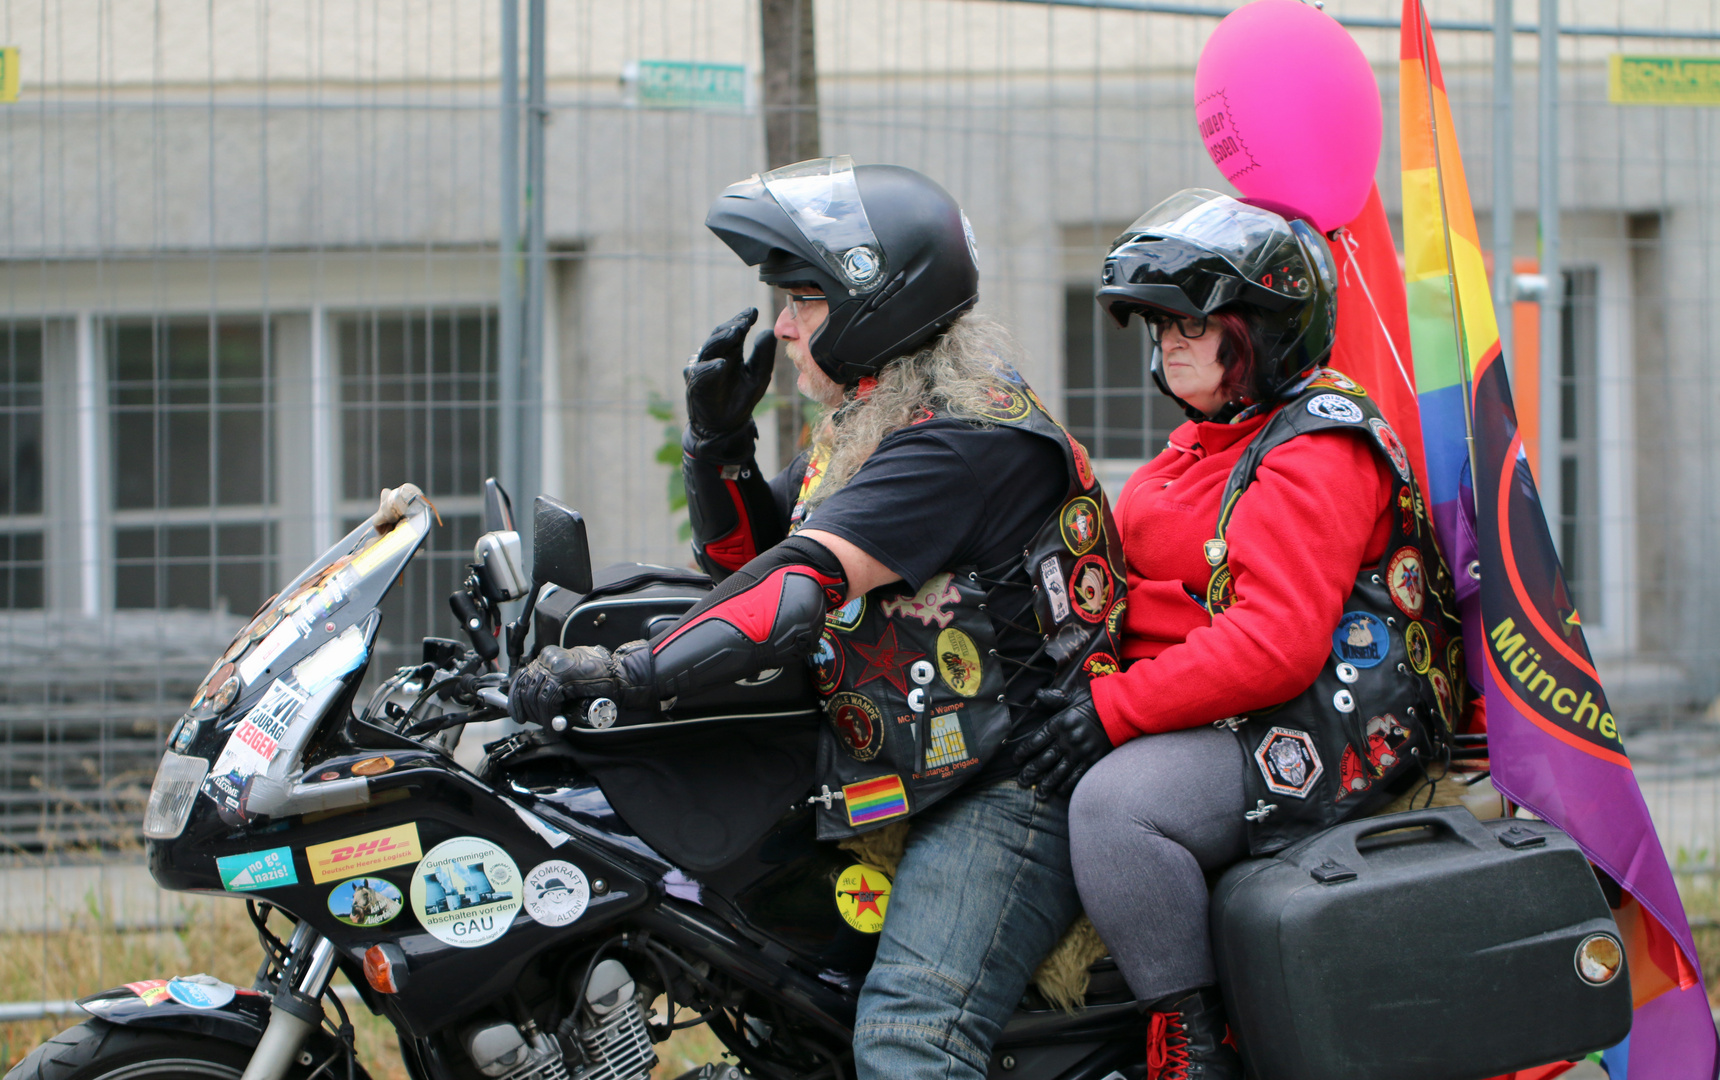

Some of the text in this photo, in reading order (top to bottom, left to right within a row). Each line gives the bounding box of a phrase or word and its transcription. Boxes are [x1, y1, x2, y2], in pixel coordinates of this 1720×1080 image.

[1214, 570, 1231, 587] KUHL
[1108, 600, 1127, 633] MC KUHL
[850, 696, 881, 720] WAMPE
[897, 714, 911, 725] MC
[935, 702, 965, 715] Wampe
[952, 757, 979, 770] brigade
[331, 837, 397, 863] DHL
[426, 849, 495, 869] Gundremmingen
[248, 852, 280, 874] no go
[254, 865, 289, 883] nazis!
[321, 850, 412, 876] Deutsche Heeres Logistik
[530, 865, 583, 887] ATOMKRAFT
[843, 877, 857, 886] MC
[427, 902, 517, 925] abschalten vor dem
[452, 915, 494, 937] GAU
